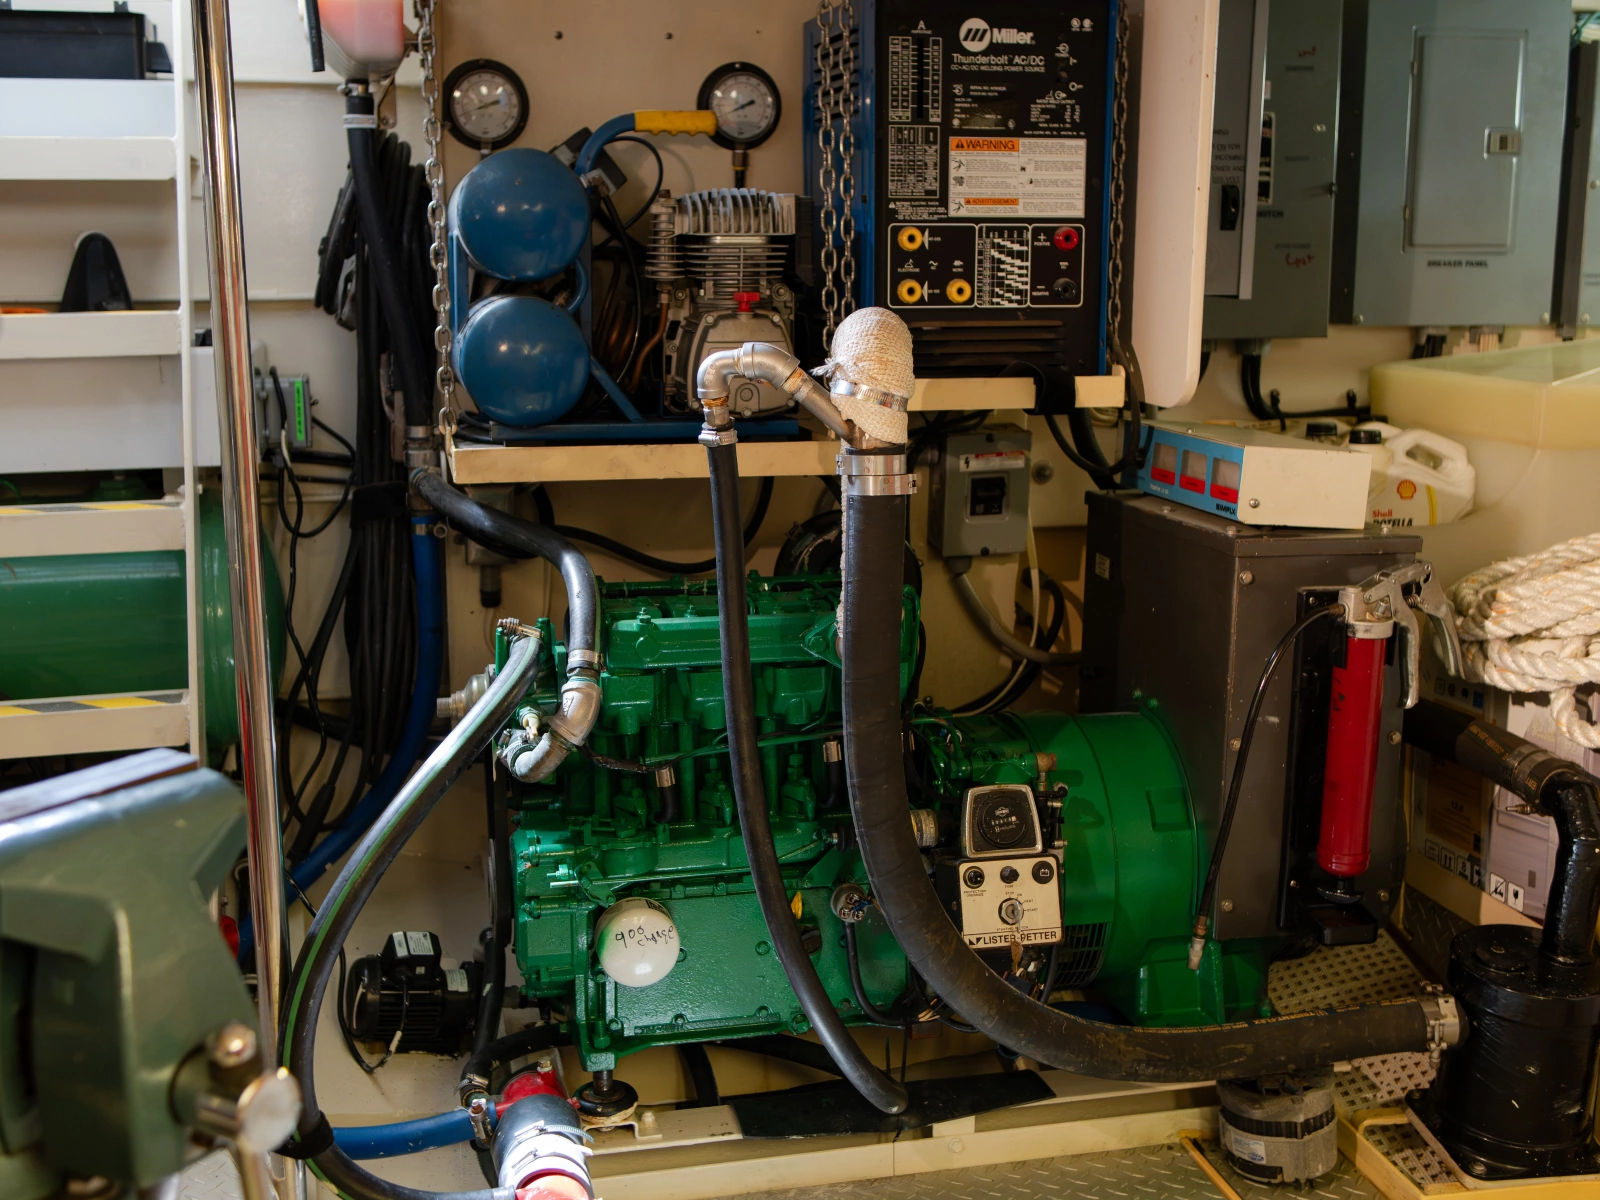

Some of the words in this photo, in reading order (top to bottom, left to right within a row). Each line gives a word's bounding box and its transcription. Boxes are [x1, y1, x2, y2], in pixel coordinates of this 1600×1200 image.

[992, 28, 1034, 44] Miller
[952, 54, 1008, 64] Thunderbolt
[1013, 55, 1045, 66] AC/DC
[966, 140, 1015, 150] WARNING
[1372, 509, 1393, 517] Shell
[983, 931, 1057, 944] LISTER-PETTER
